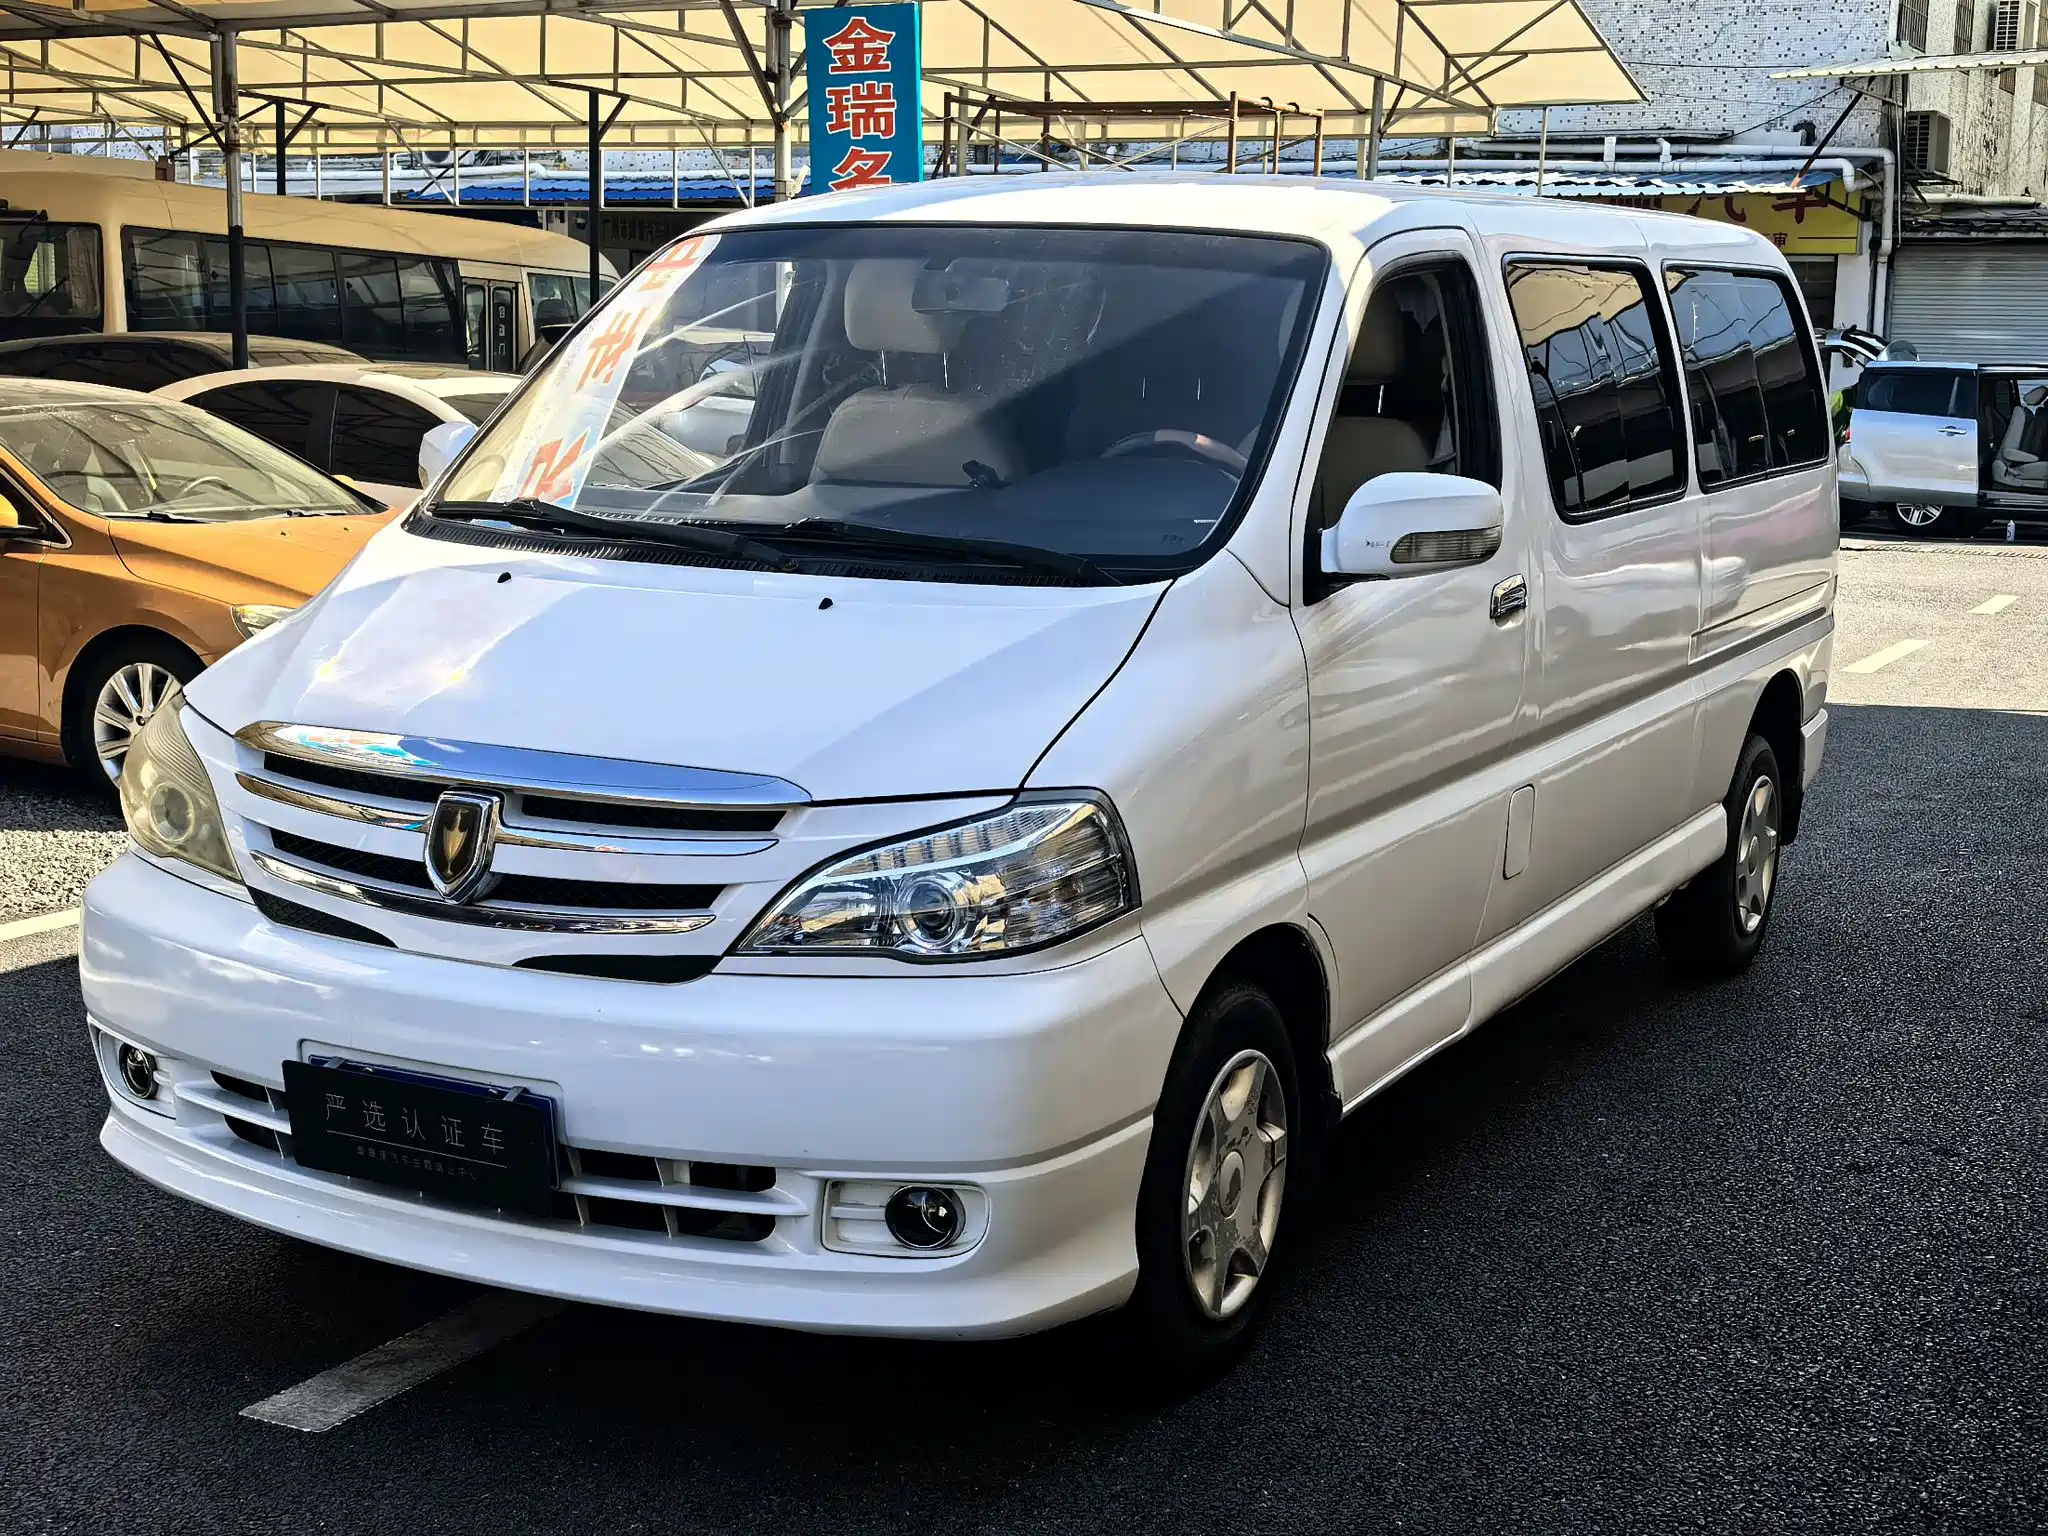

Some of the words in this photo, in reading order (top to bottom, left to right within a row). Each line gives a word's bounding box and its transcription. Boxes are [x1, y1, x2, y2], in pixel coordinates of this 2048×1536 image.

[823, 16, 897, 192] 金瑞名
[324, 1093, 504, 1155] 严选认证车
